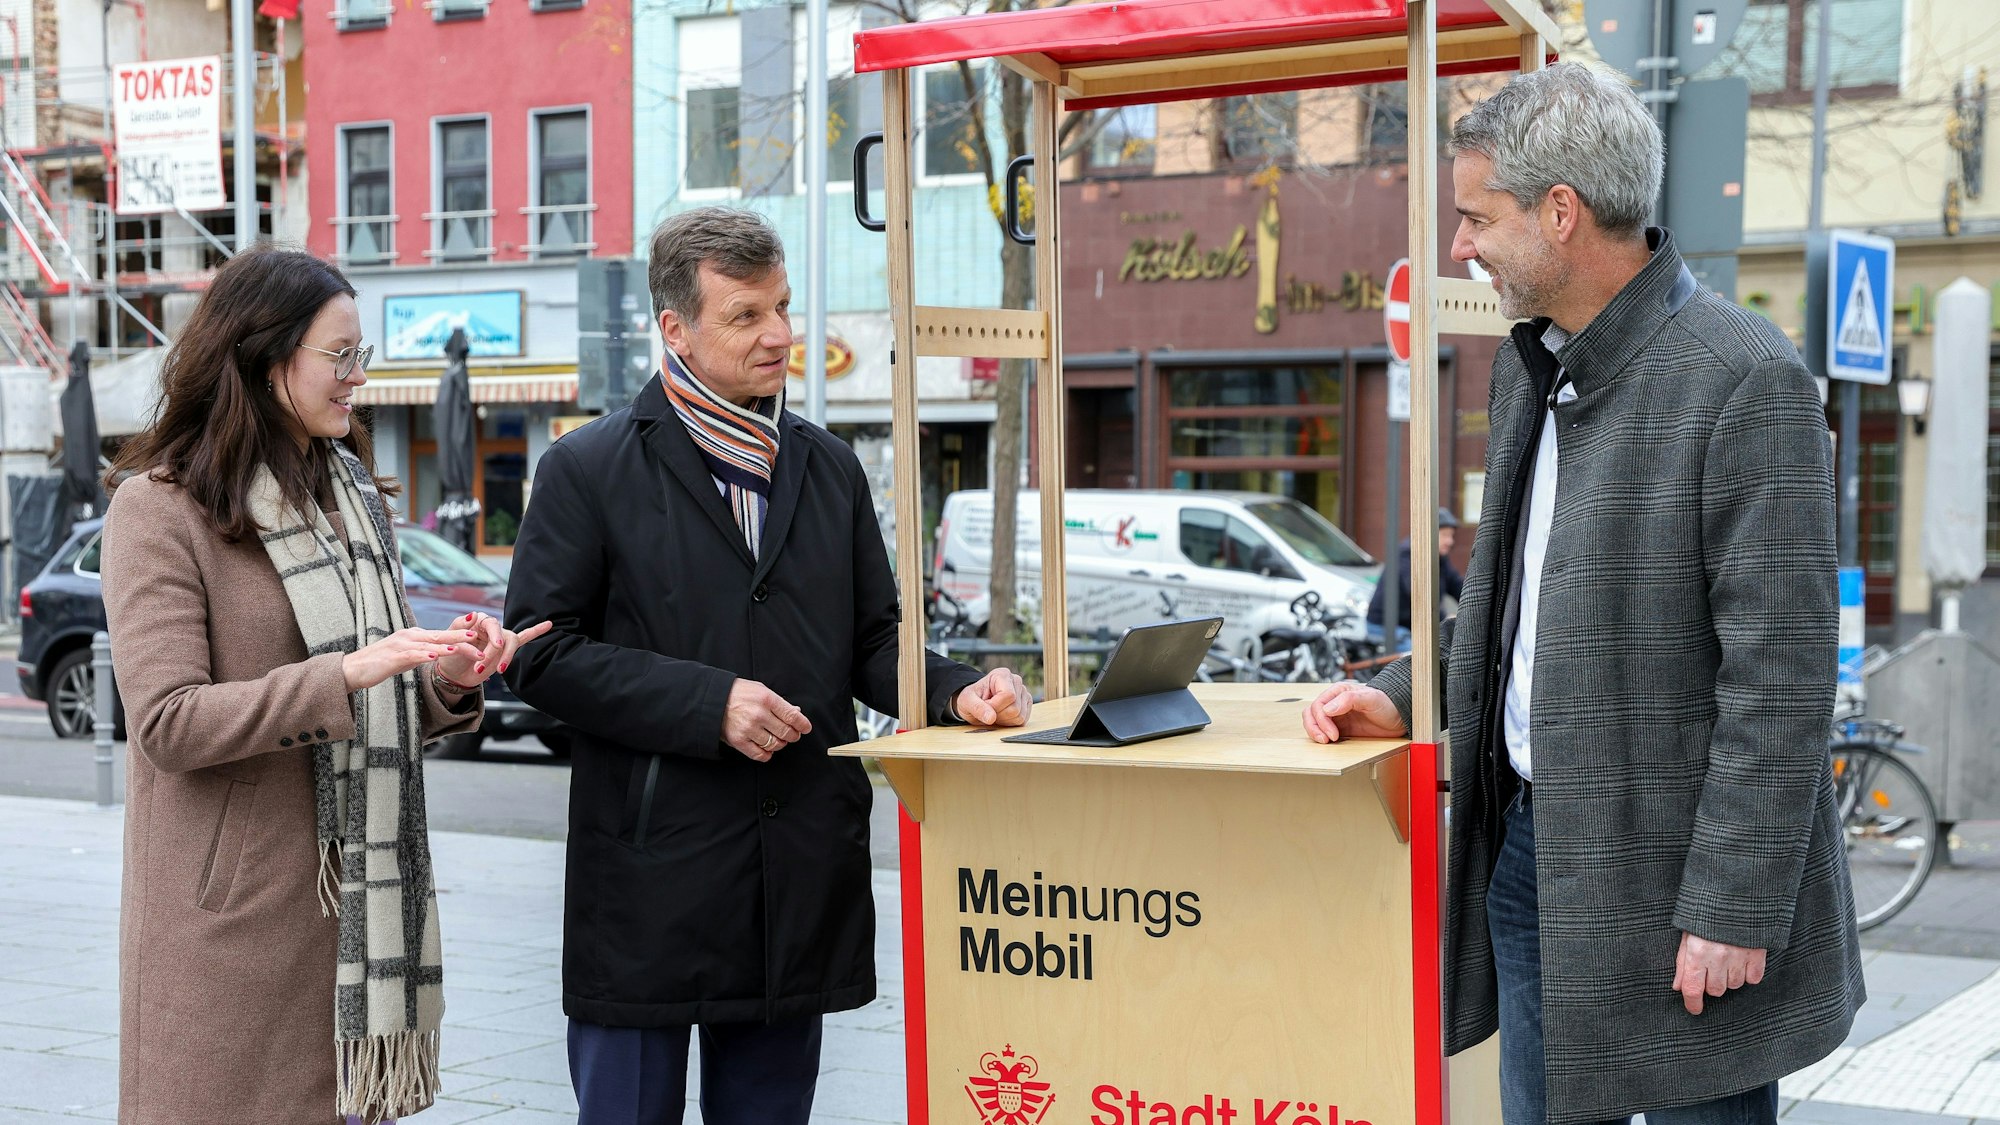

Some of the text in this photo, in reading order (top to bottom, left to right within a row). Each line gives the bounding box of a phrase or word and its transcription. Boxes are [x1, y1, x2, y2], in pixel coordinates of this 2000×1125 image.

[120, 64, 213, 102] TOKTAS
[1118, 224, 1250, 283] Kölsch
[958, 867, 1202, 938] Meinungs
[960, 926, 1093, 980] Mobil
[1091, 1085, 1238, 1125] Stadt
